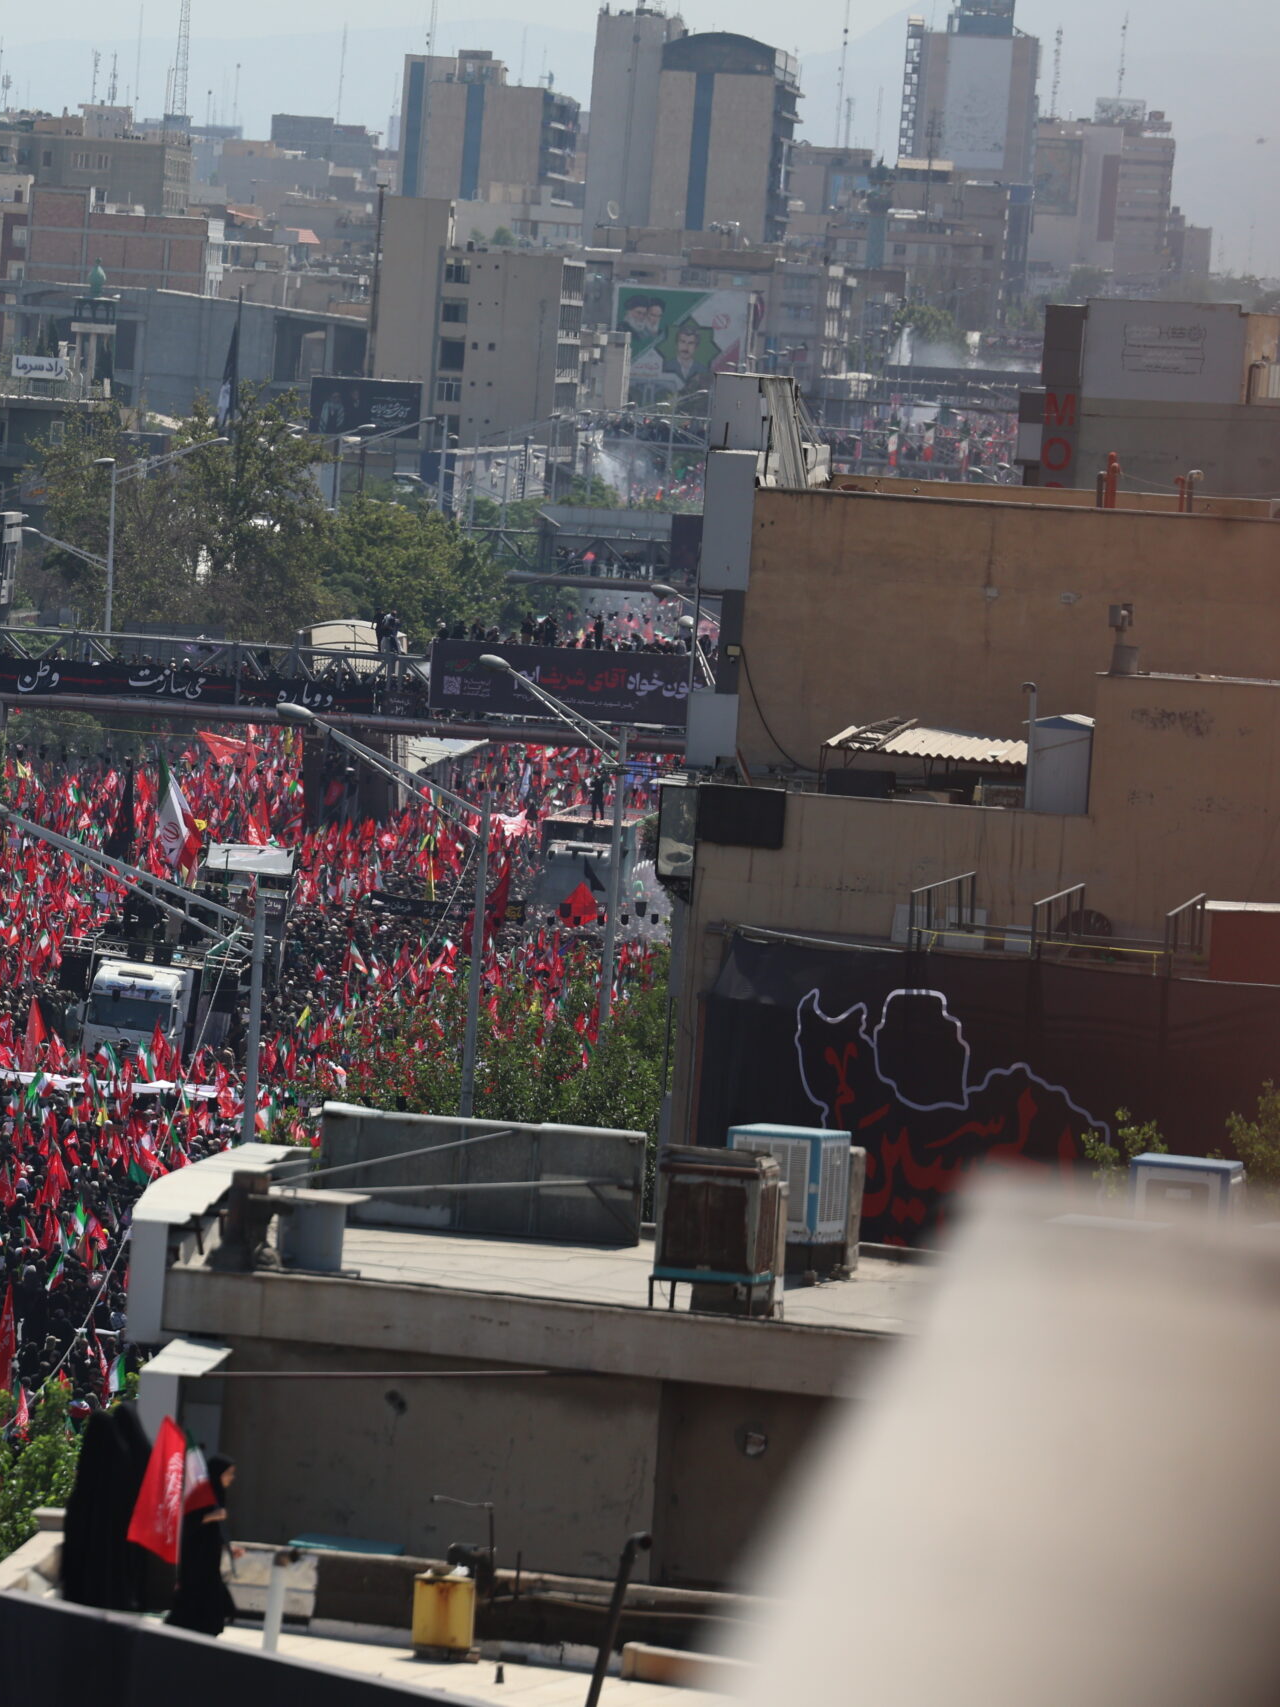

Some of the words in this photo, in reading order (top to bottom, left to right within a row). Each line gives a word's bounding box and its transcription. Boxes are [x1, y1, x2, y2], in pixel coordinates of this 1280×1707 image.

[1041, 392, 1076, 488] MO
[17, 660, 60, 692] وطن
[276, 682, 334, 708] دوباره
